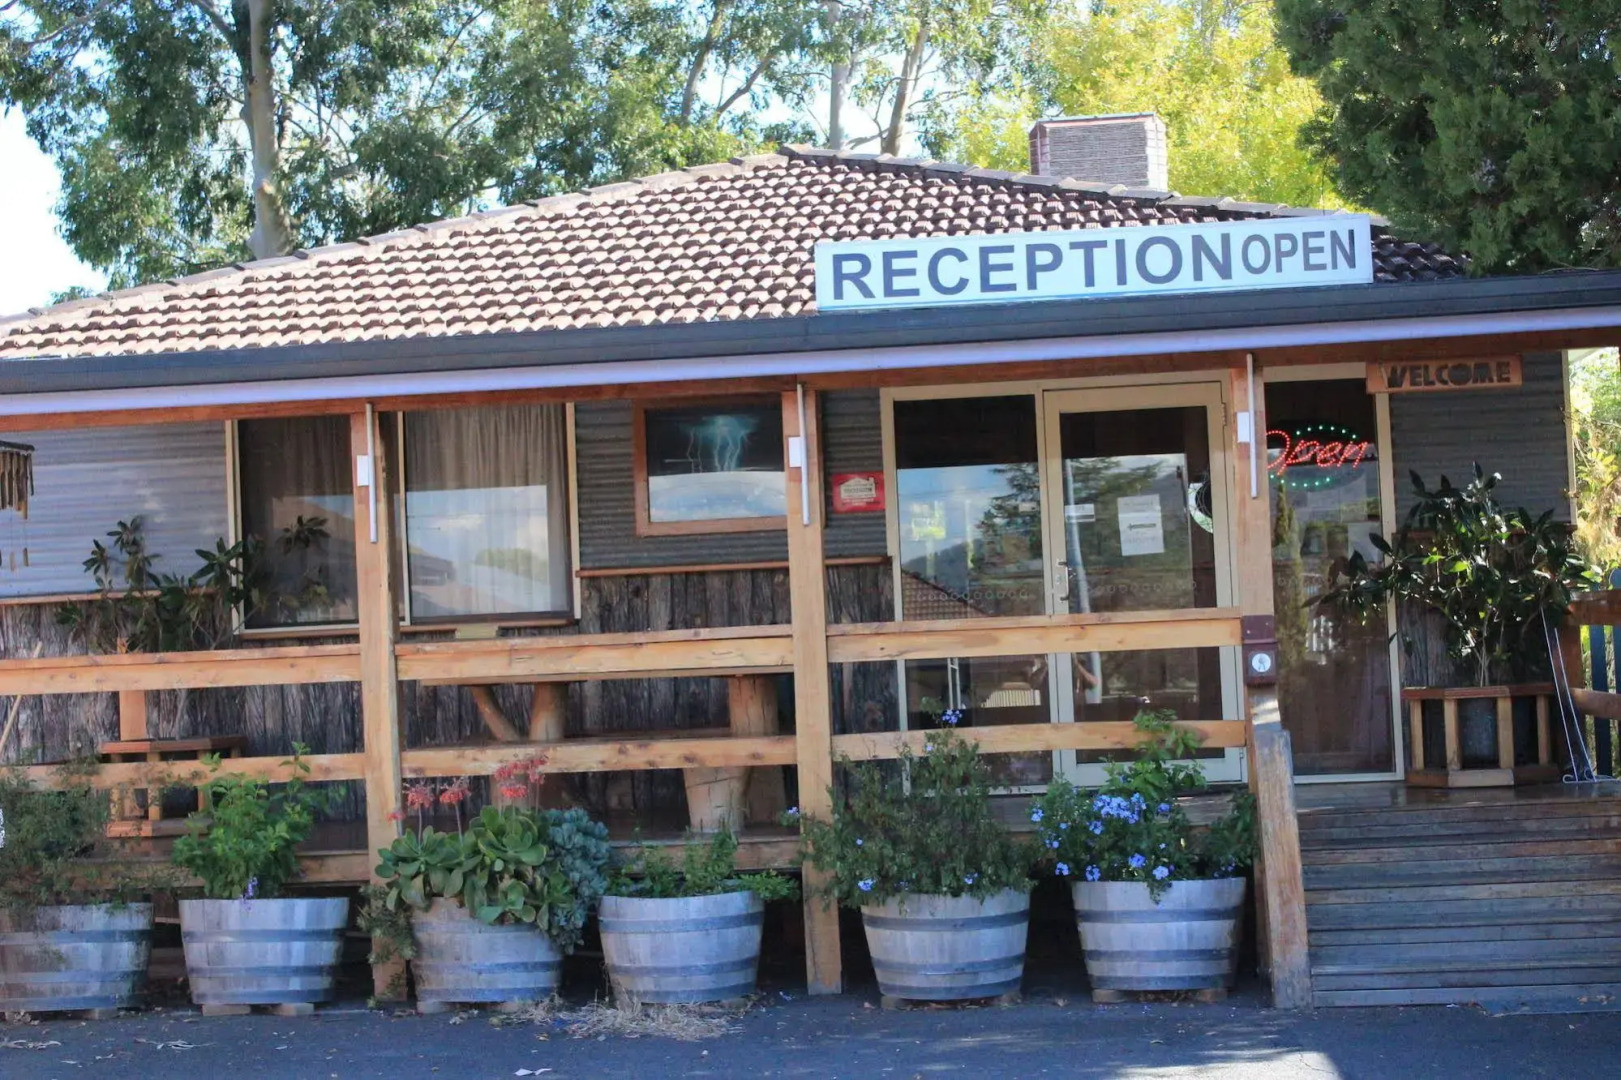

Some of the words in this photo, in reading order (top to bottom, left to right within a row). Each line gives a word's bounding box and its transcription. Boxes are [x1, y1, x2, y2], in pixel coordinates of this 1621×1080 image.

[832, 231, 1232, 300] RECEPTION
[1241, 229, 1356, 275] OPEN
[1384, 361, 1511, 389] WELCOME
